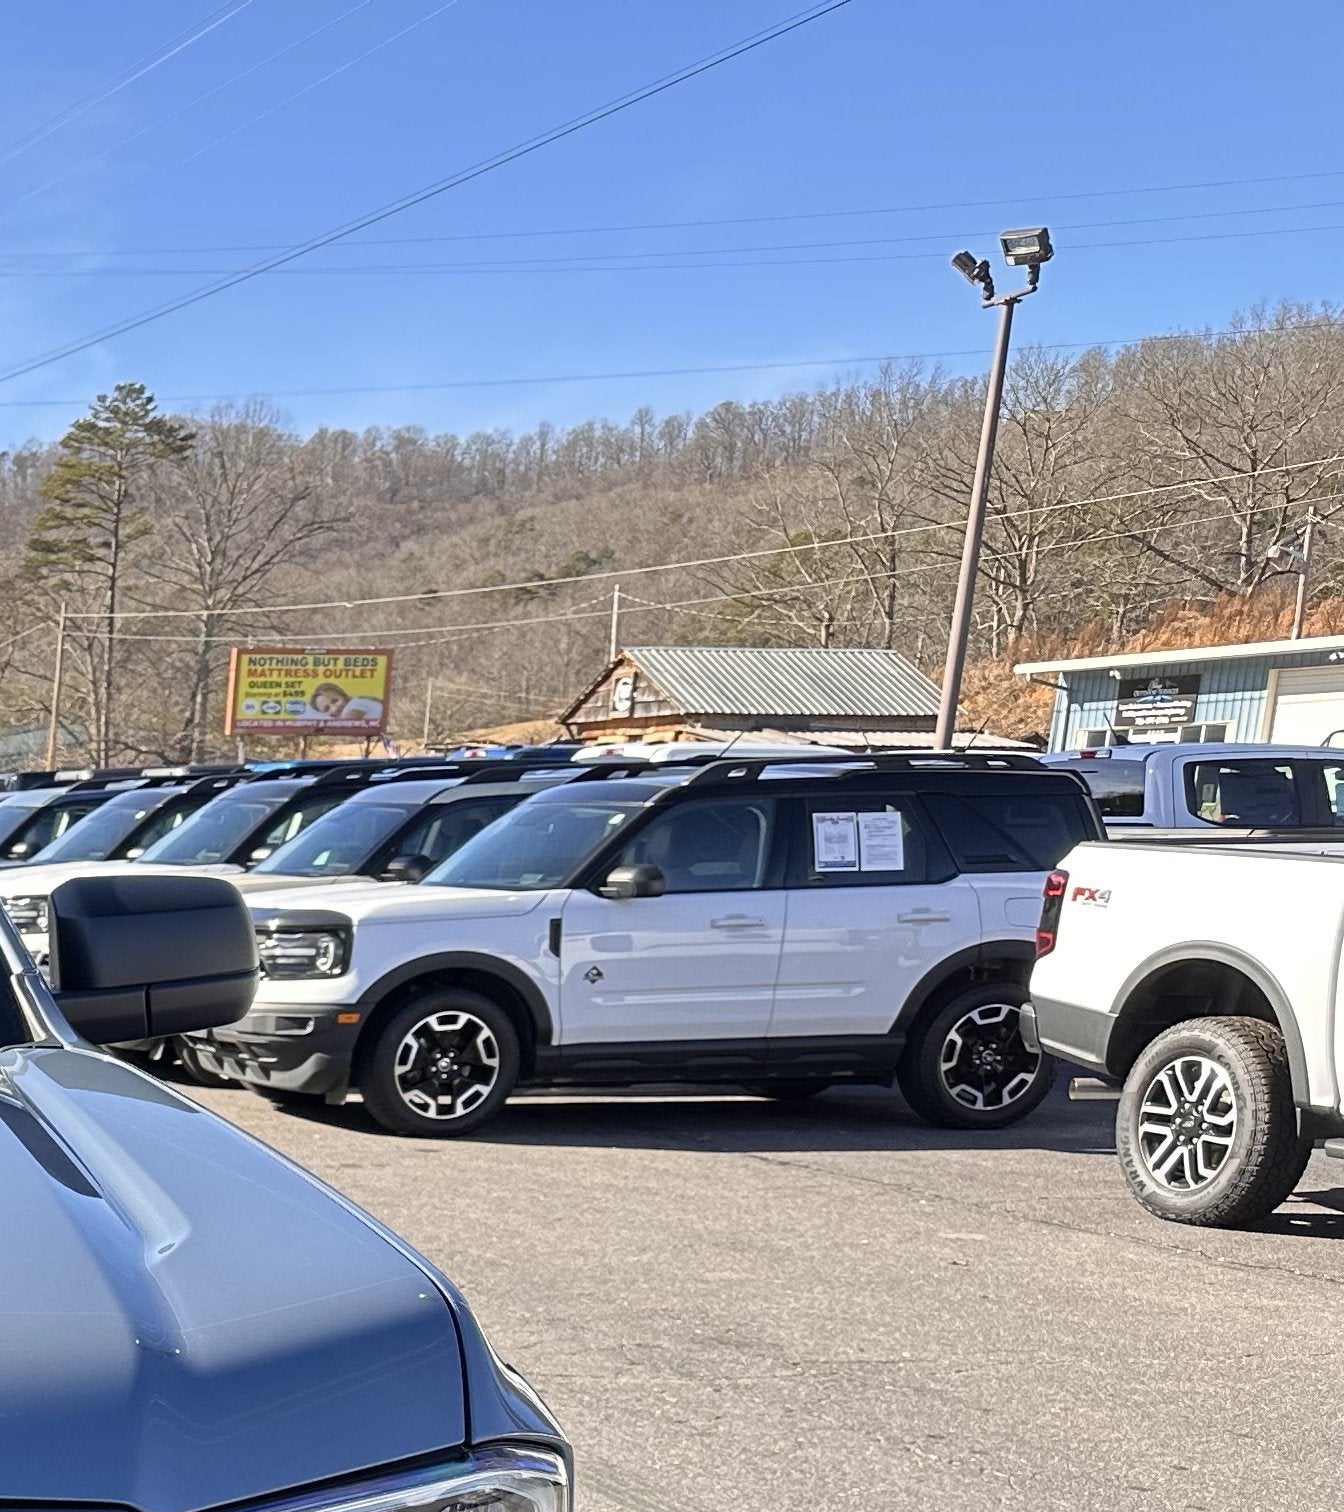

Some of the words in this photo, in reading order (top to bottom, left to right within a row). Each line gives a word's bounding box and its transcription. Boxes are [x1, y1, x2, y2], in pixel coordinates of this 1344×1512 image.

[248, 656, 309, 667] NOTHING
[313, 656, 340, 667] BUT
[344, 656, 378, 667] BEDS
[247, 668, 320, 679] MATTRESS
[323, 668, 378, 679] OUTLET
[248, 681, 282, 689] QUEEN
[285, 681, 303, 689] SET
[1071, 886, 1113, 903] FX4
